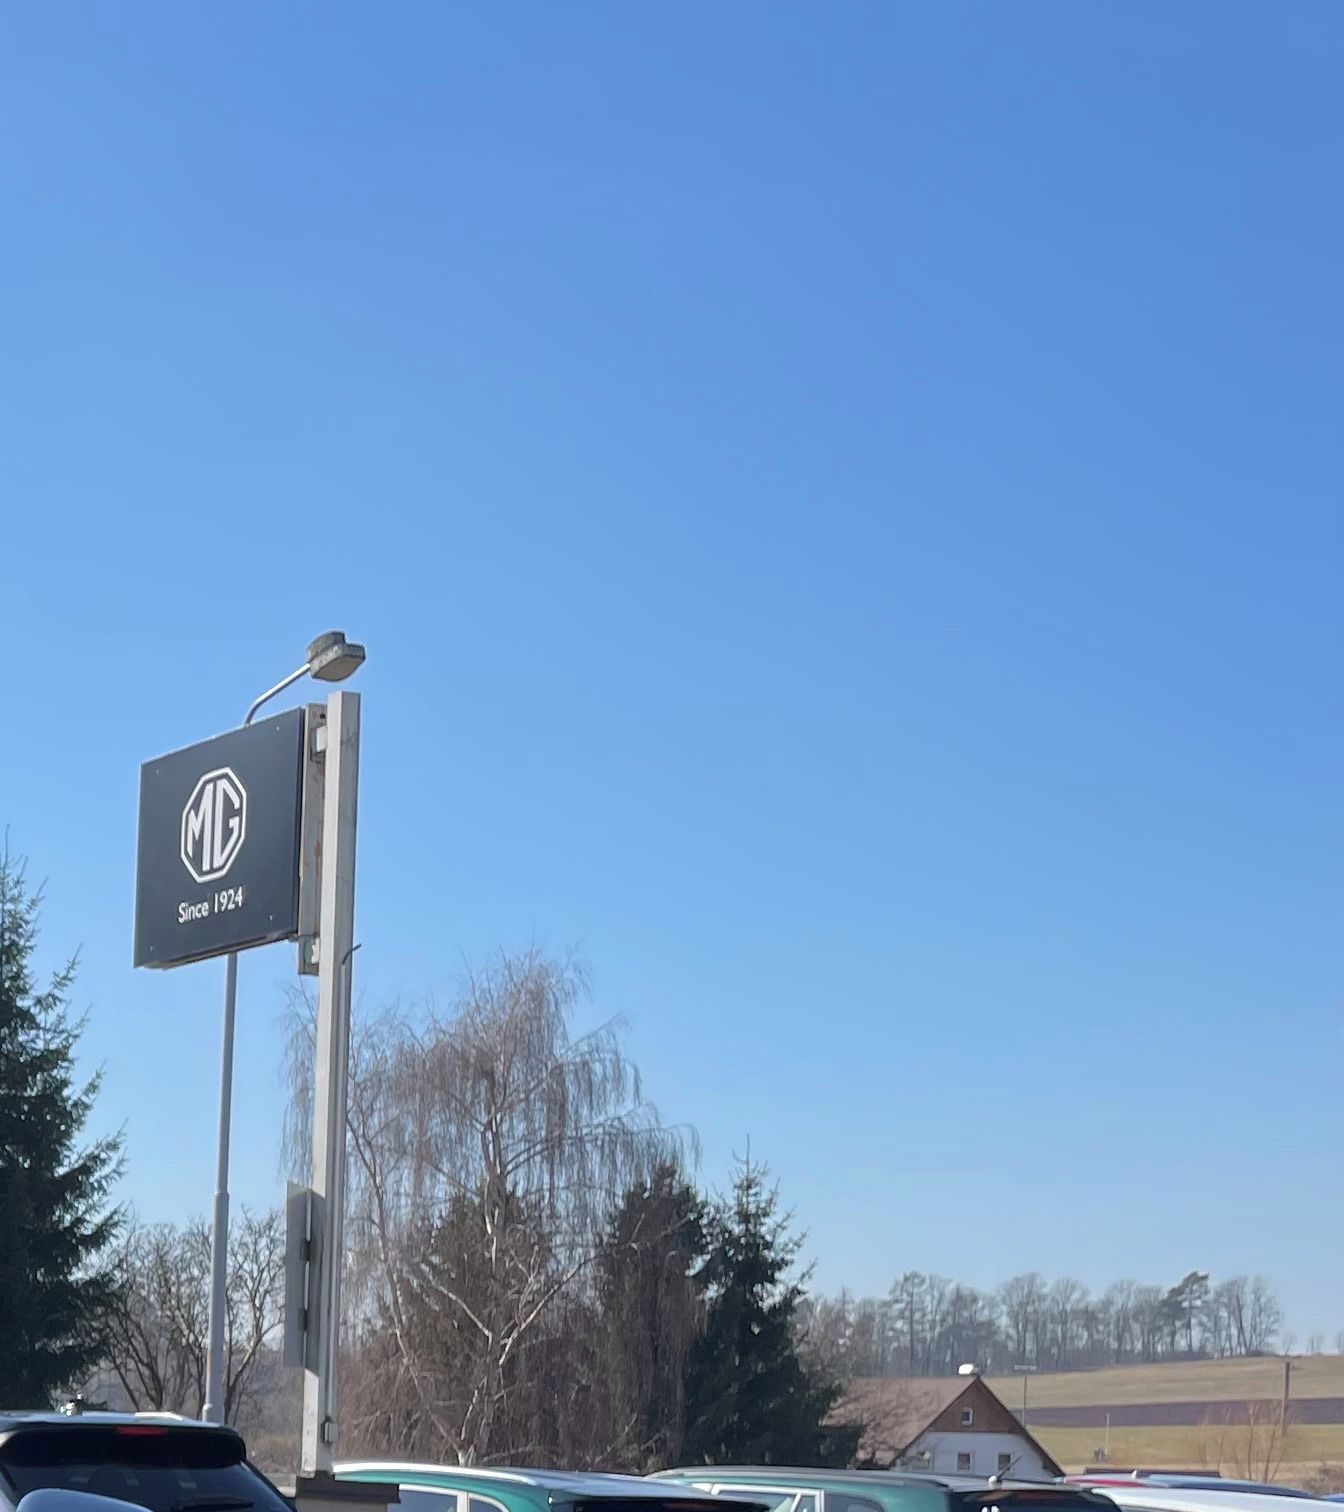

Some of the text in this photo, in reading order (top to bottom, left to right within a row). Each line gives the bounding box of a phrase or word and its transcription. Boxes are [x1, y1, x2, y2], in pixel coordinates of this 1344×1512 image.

[187, 778, 241, 872] MG
[178, 886, 244, 924] Since 1924
